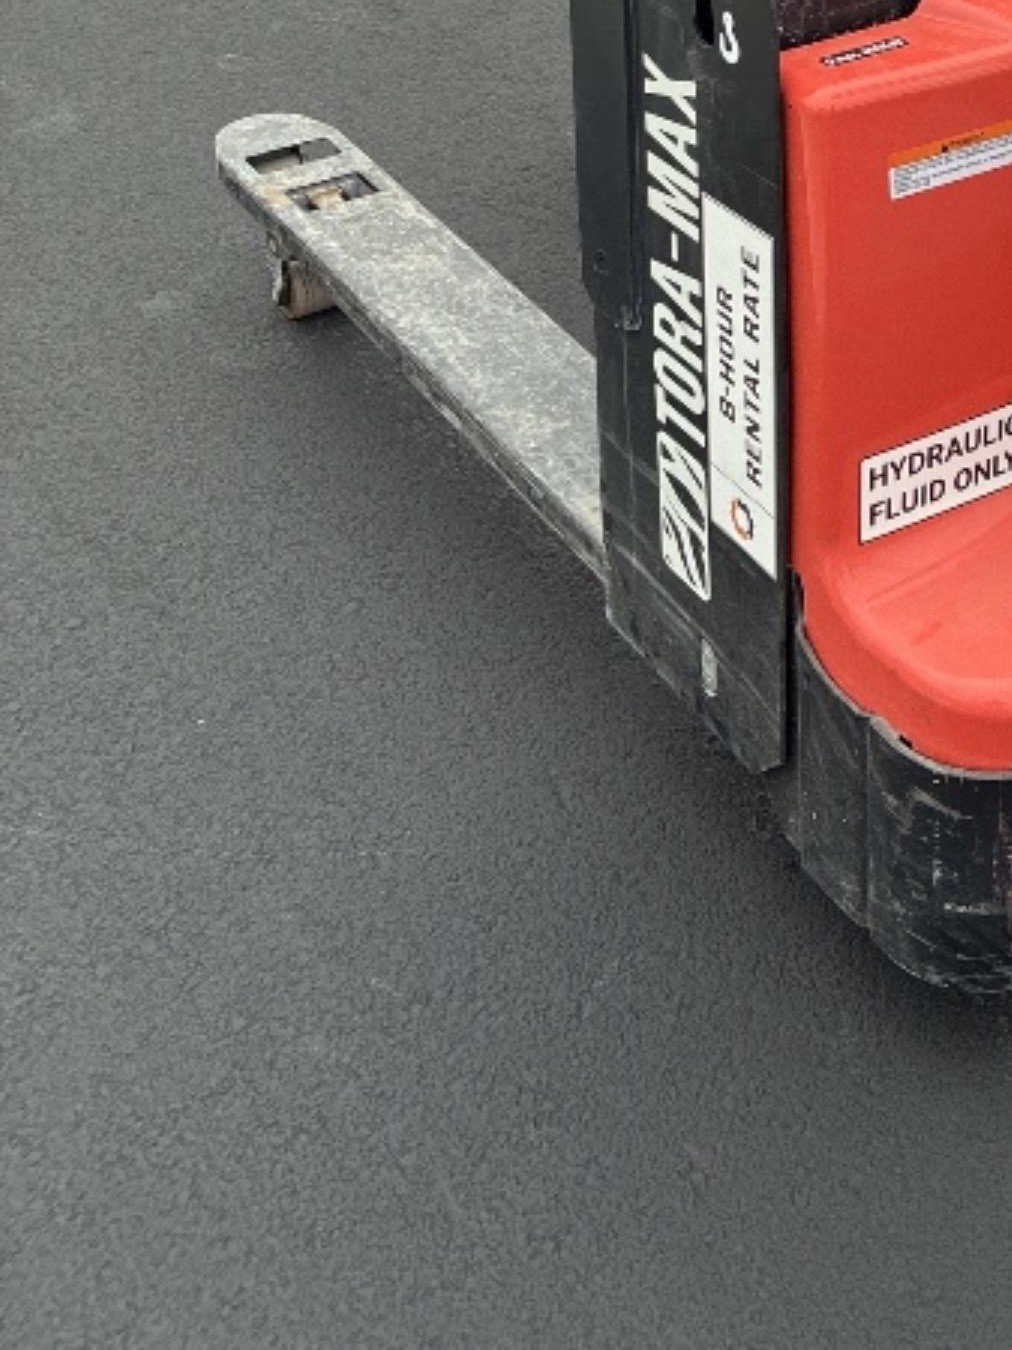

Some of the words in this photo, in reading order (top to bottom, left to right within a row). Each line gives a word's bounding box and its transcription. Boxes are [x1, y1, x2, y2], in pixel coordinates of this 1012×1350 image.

[642, 52, 706, 448] TORA-MAX
[741, 246, 761, 342] RATE
[716, 286, 736, 423] 8-HOUR
[743, 358, 763, 488] RENTAL
[868, 479, 946, 527] FLUID
